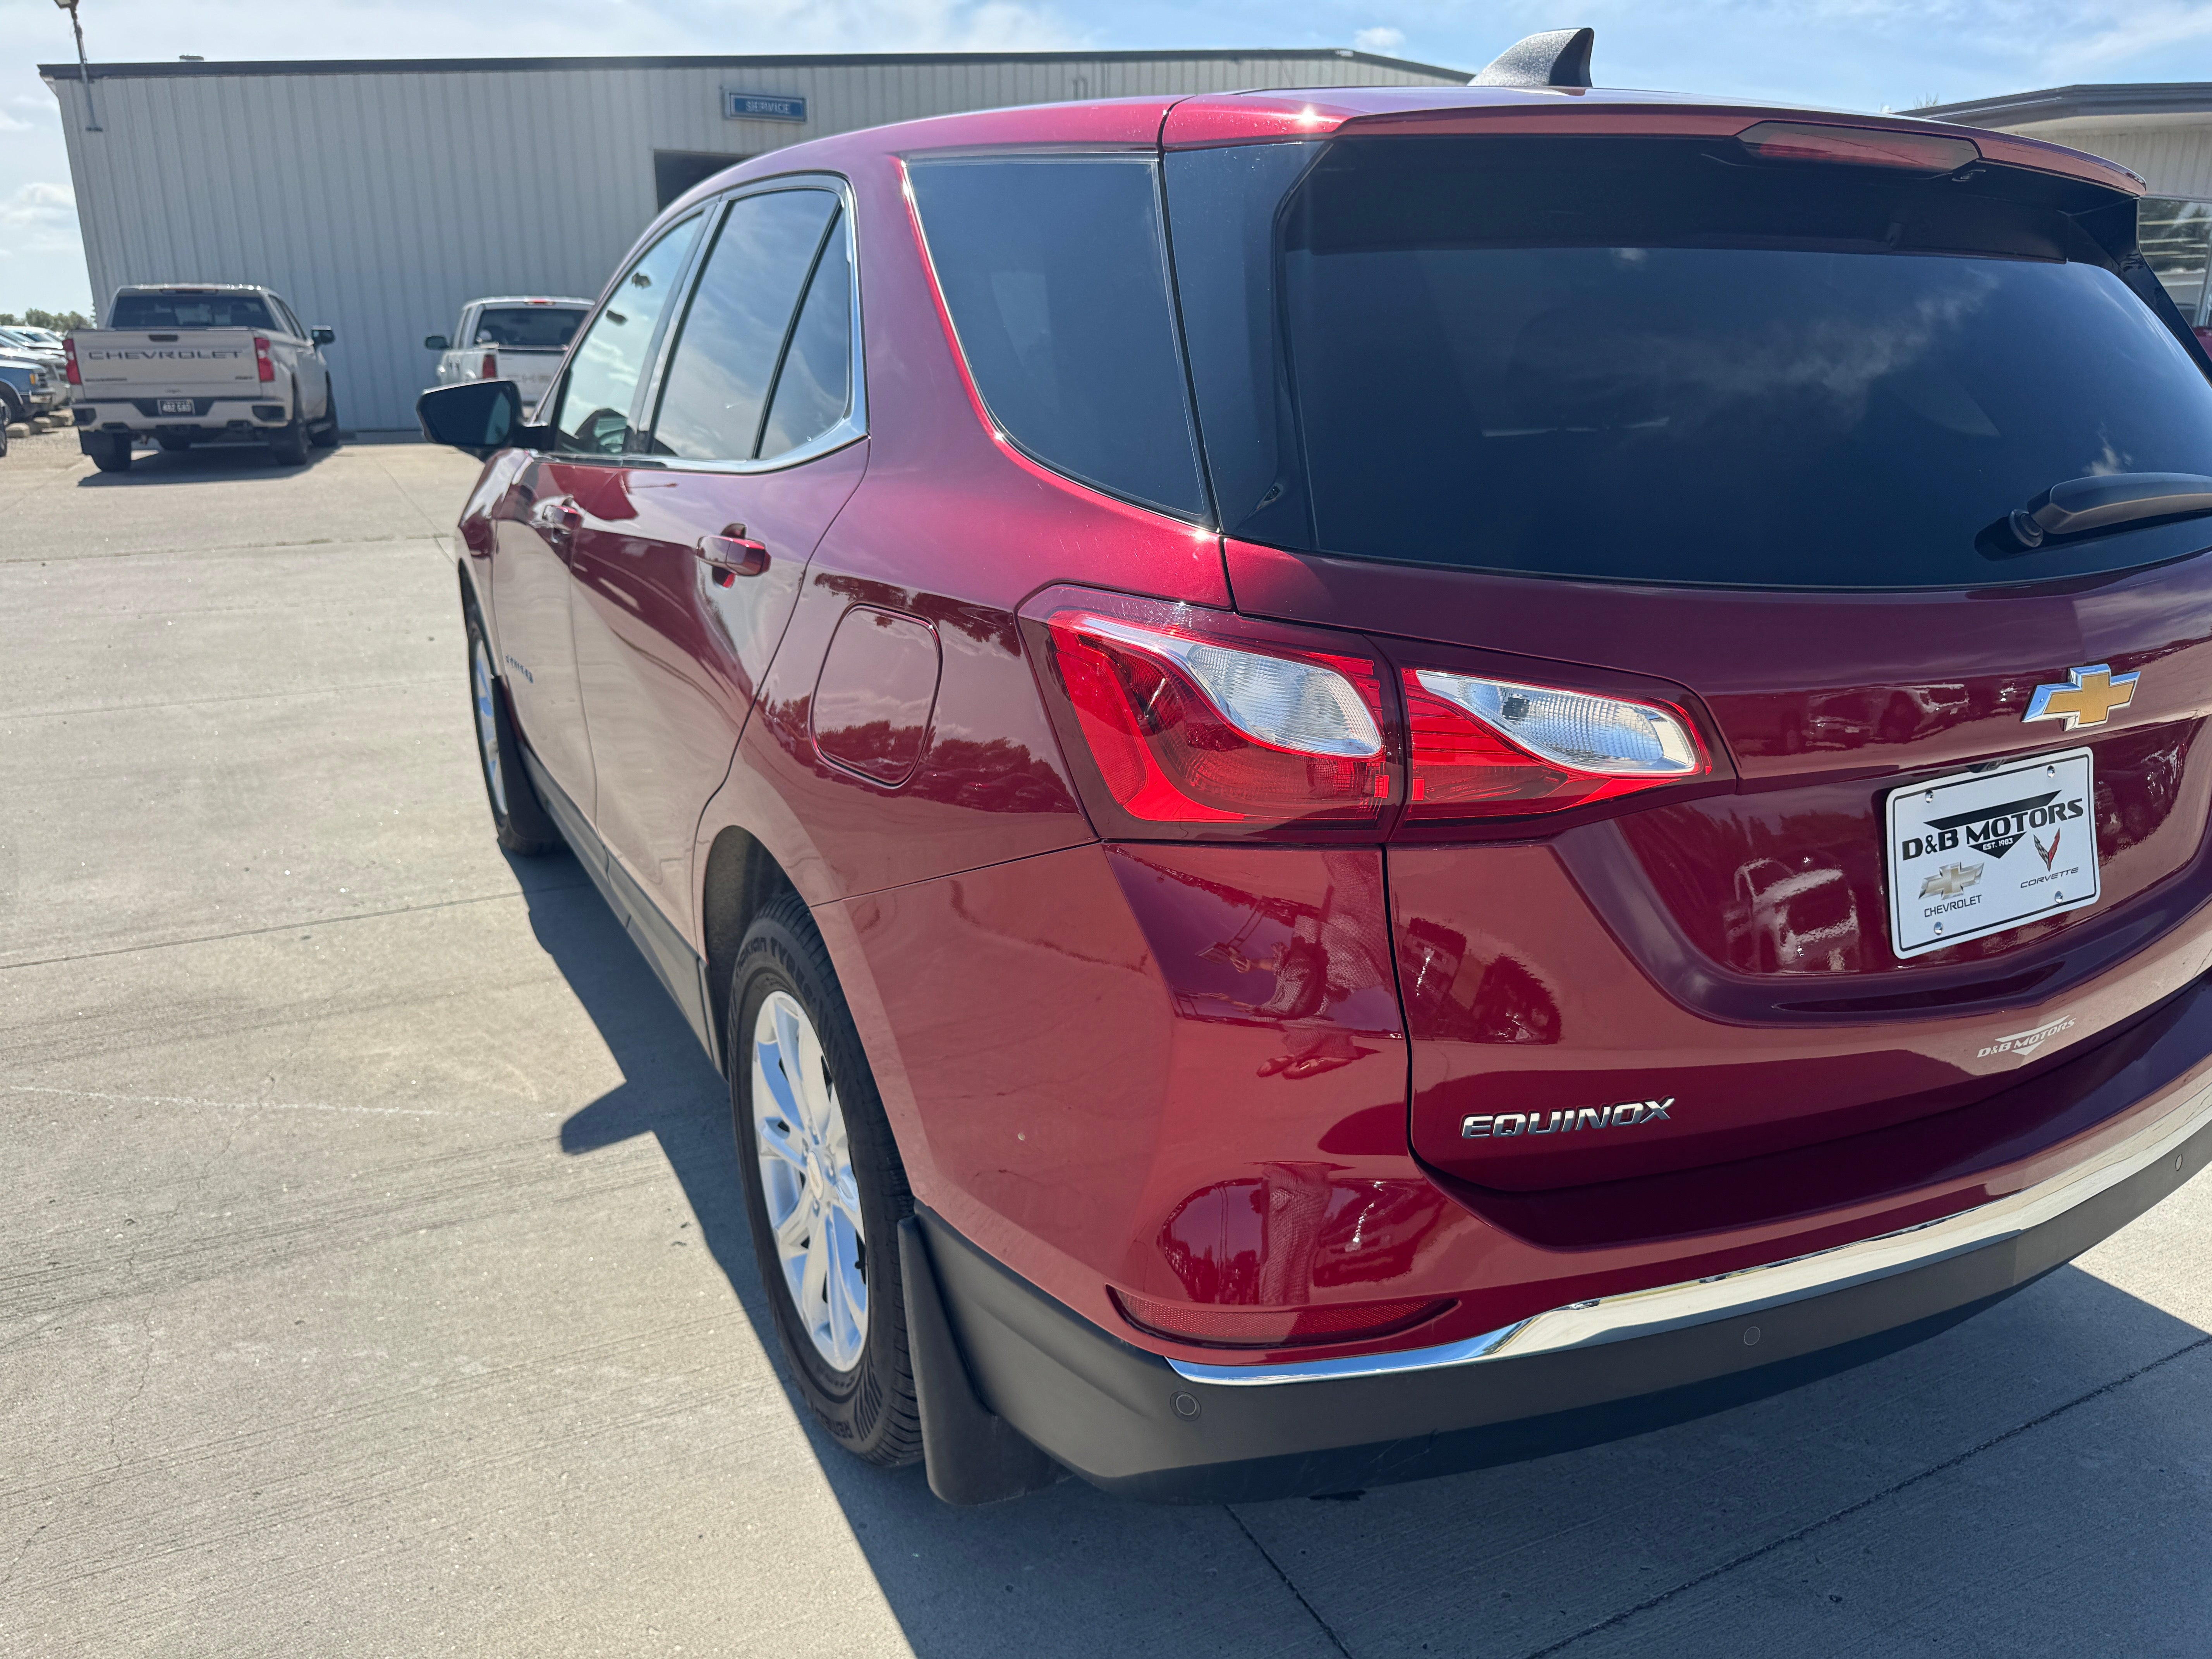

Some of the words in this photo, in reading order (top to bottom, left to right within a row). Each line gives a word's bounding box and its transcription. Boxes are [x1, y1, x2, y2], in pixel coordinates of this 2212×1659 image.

[745, 100, 790, 114] SERVICE
[89, 351, 242, 360] CHEVROLET
[1902, 829, 1959, 860] D&B
[1966, 798, 2083, 845] MOTORS
[1983, 842, 1997, 850] EST.
[1998, 838, 2013, 847] 1983
[2020, 867, 2079, 888] CORVETTE
[1924, 894, 1982, 918] CHEVROLET
[1977, 1042, 2011, 1058] D&B
[2014, 1018, 2076, 1048] MOTORS
[1461, 1096, 1675, 1139] EQUINOX
